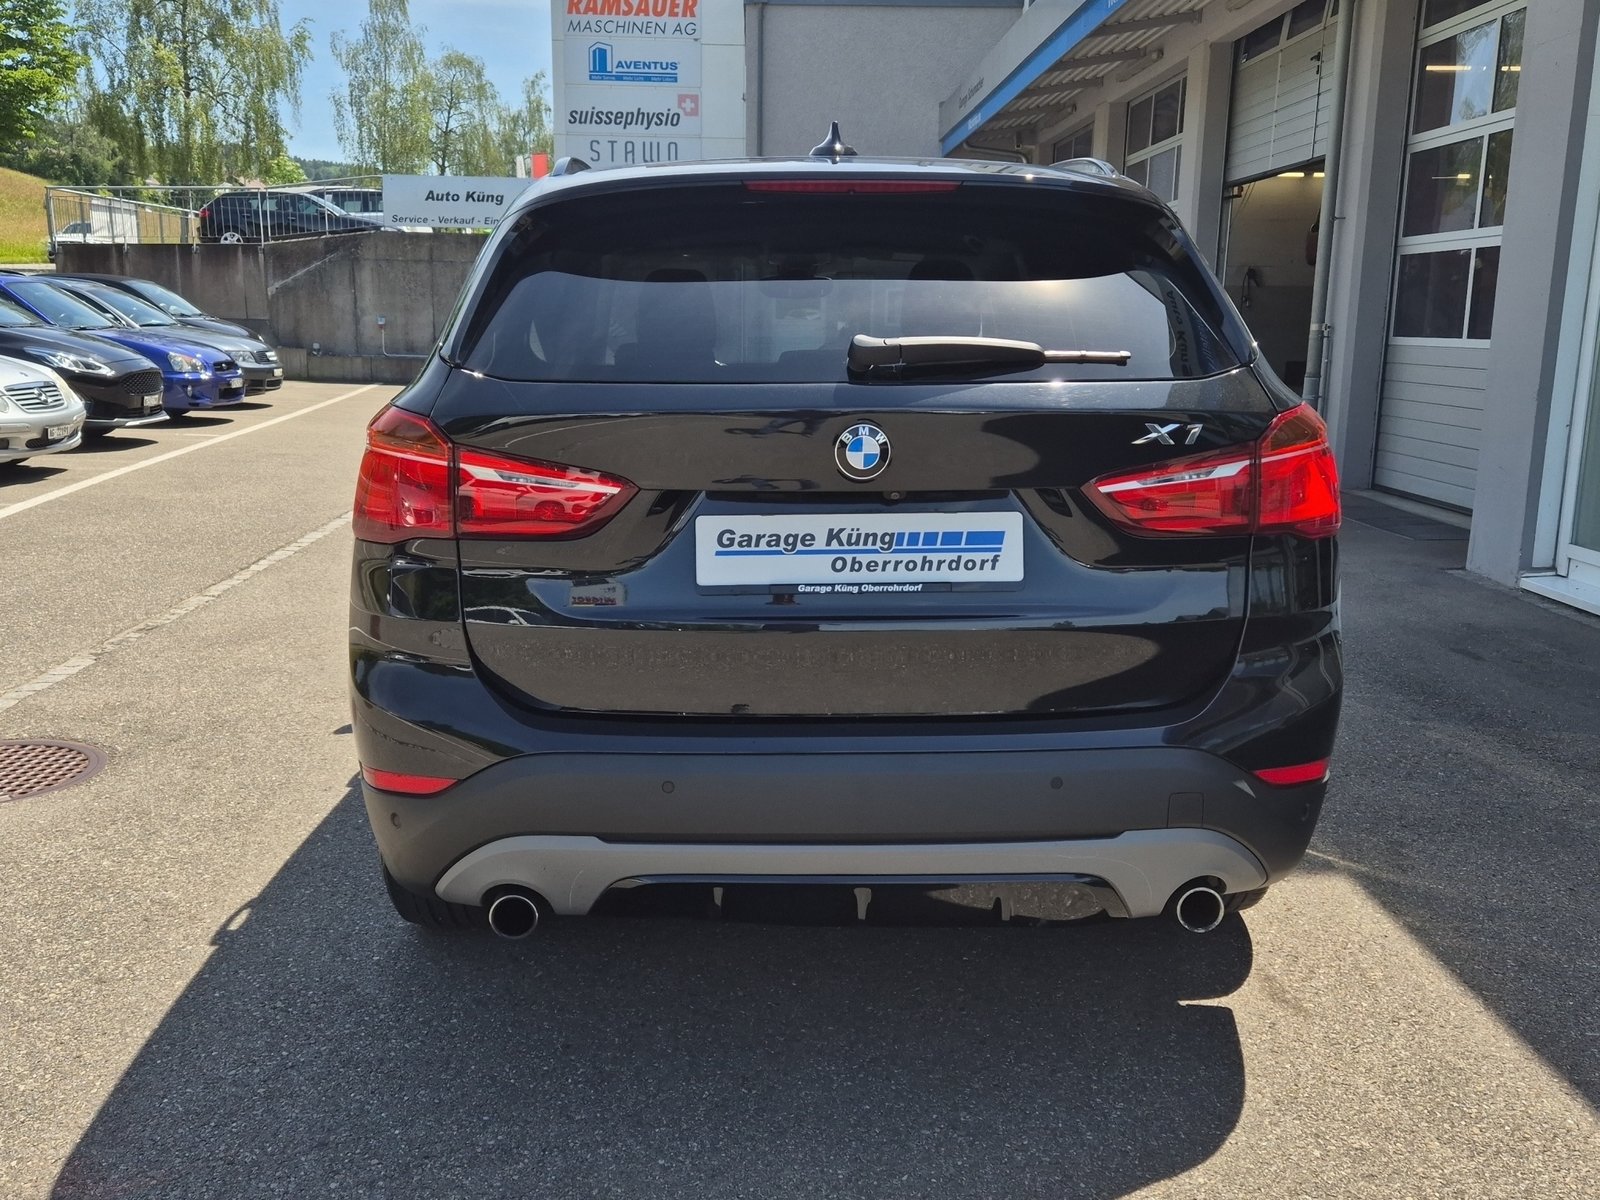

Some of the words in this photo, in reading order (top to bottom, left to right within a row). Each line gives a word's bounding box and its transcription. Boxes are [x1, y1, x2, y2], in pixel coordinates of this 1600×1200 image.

[566, 0, 698, 17] RAMSAUER
[567, 20, 667, 35] MASCHINEN
[671, 22, 697, 36] AG
[615, 60, 678, 71] AVENTUS
[568, 106, 681, 130] suissephysio
[425, 190, 460, 202] Auto
[465, 191, 504, 206] Küng
[391, 214, 428, 223] Service
[438, 216, 475, 225] Verkauf
[841, 426, 887, 445] BMW
[1131, 423, 1203, 445] X1
[716, 528, 816, 553] Garage
[825, 527, 896, 553] Küng
[830, 554, 1001, 573] Oberrohrdorf
[797, 584, 832, 594] Garage
[834, 584, 859, 593] Küng
[861, 583, 923, 592] Oberrohrdorf
